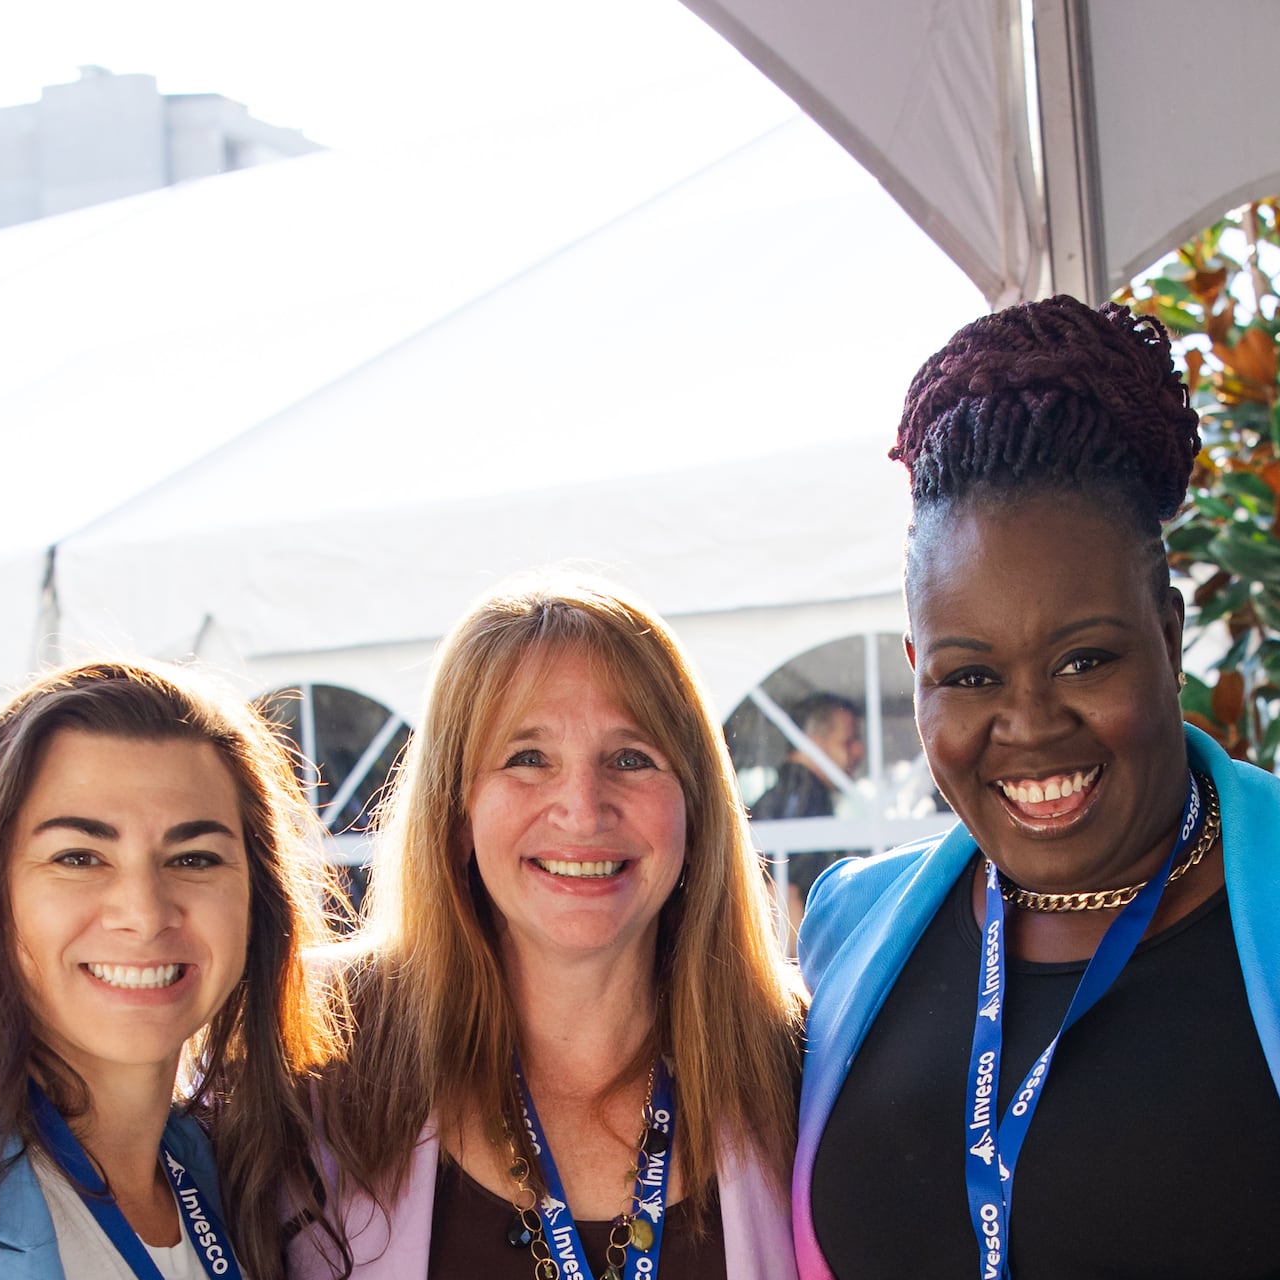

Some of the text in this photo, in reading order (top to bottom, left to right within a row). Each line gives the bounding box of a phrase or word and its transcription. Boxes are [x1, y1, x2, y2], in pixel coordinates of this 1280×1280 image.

[980, 919, 1000, 997] Invesco
[969, 1050, 995, 1129] Invesco
[179, 1187, 228, 1276] Invesco
